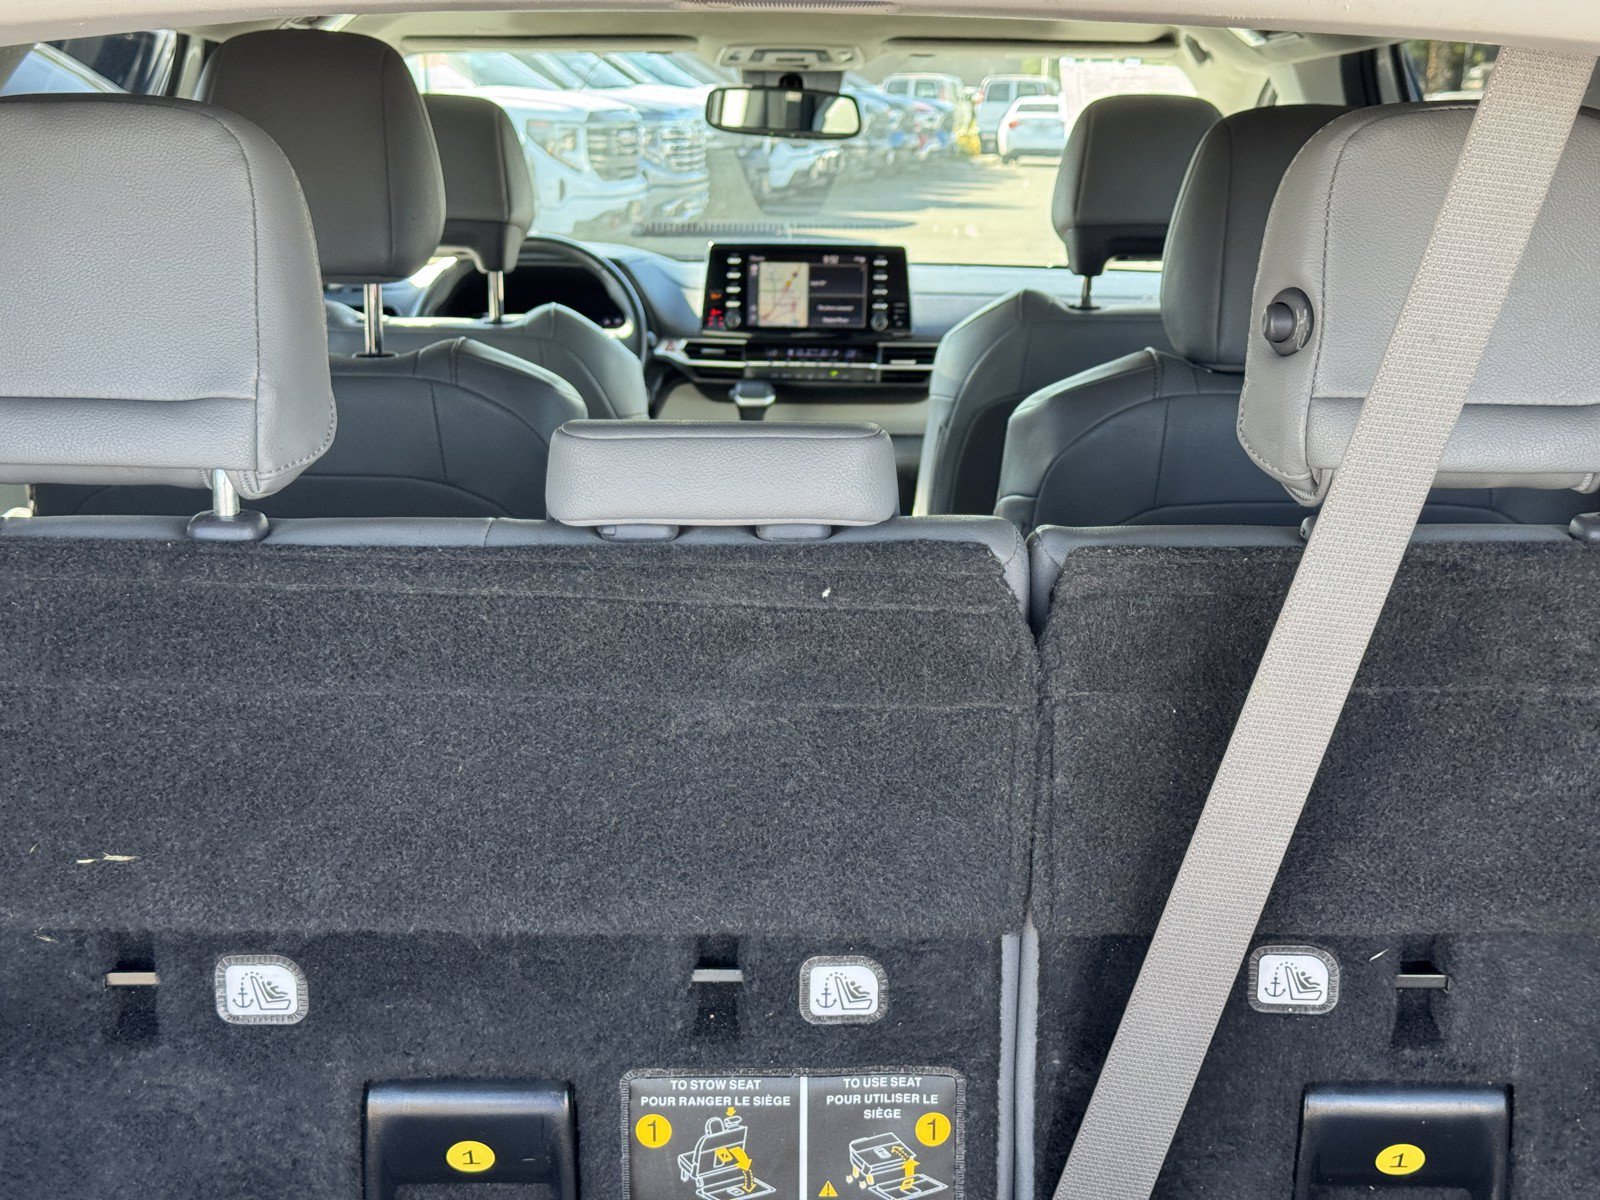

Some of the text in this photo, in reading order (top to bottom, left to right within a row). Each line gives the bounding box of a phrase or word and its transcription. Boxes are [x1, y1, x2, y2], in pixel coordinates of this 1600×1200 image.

[670, 1079, 761, 1090] TO STOW SEAT
[843, 1077, 922, 1088] TO USE SEAT
[640, 1093, 791, 1106] POUR RANGER LE SIÈGE
[826, 1093, 939, 1105] POUR UTILISER LE
[863, 1106, 901, 1119] SIÈGE
[646, 1119, 658, 1143] 1
[926, 1118, 936, 1141] 1
[462, 1149, 482, 1165] 1
[1389, 1152, 1408, 1168] 1
